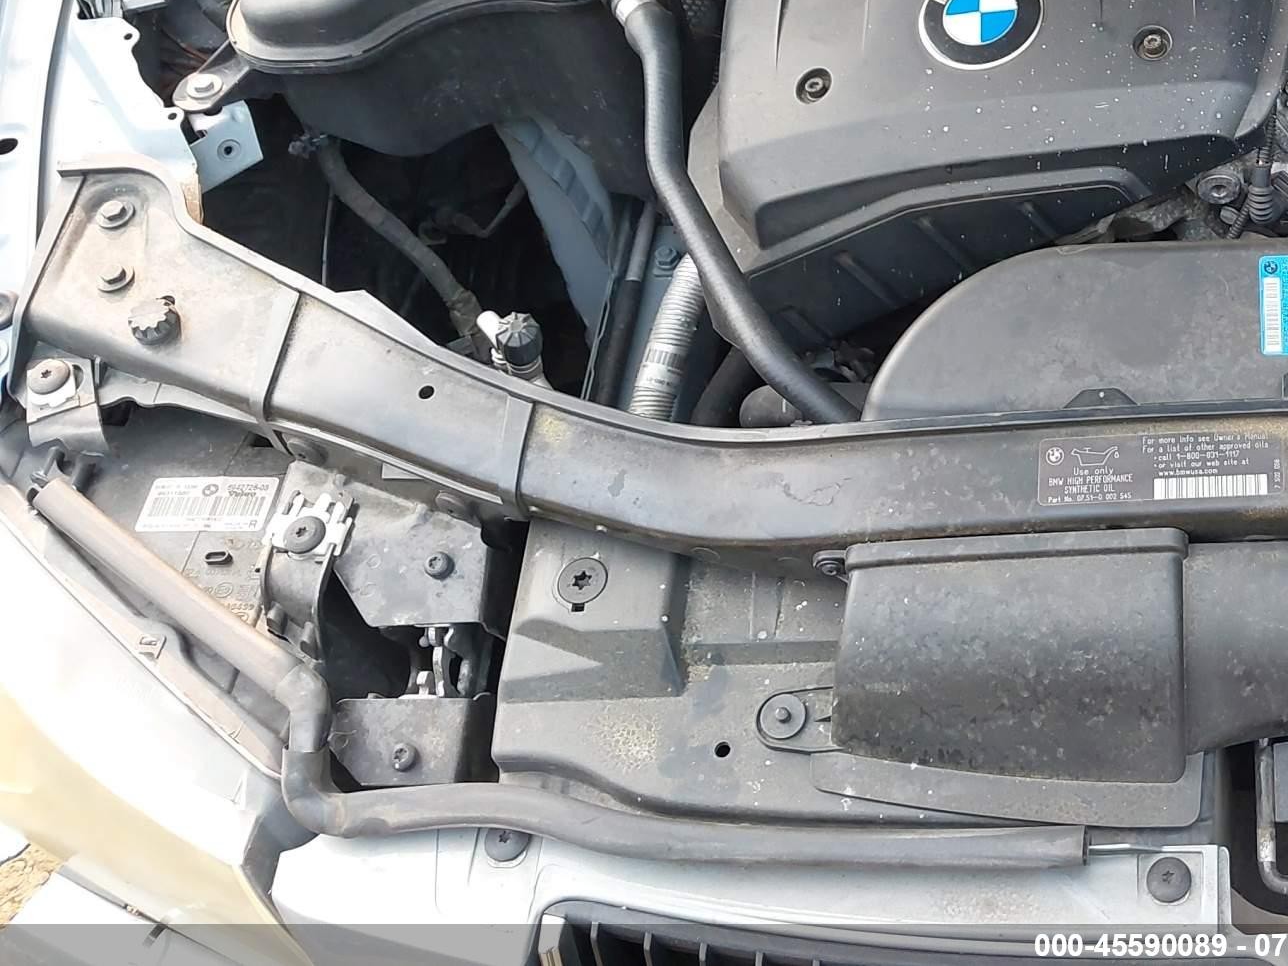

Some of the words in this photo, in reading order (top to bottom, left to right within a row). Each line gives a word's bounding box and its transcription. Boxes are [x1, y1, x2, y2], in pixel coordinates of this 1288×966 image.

[1142, 436, 1154, 445] For
[1142, 444, 1154, 454] For
[1166, 443, 1180, 453] list
[1184, 442, 1192, 452] of
[1196, 442, 1215, 451] other
[1219, 441, 1251, 452] approved
[1254, 440, 1269, 449] oils
[1158, 452, 1172, 461] call
[1169, 459, 1187, 468] visit
[1206, 459, 1220, 467] web
[1223, 458, 1239, 466] site
[1241, 457, 1249, 466] at
[1073, 467, 1089, 475] Use
[1094, 465, 1114, 476] only
[1158, 468, 1219, 476] www.bmwusa.com
[1048, 477, 1064, 487] BMW
[1067, 476, 1084, 485] HIGH
[1086, 473, 1133, 484] PERFORMANCE
[1064, 484, 1100, 494] SYNTHETIC
[1103, 483, 1115, 492] OIL
[1047, 495, 1061, 503] Part
